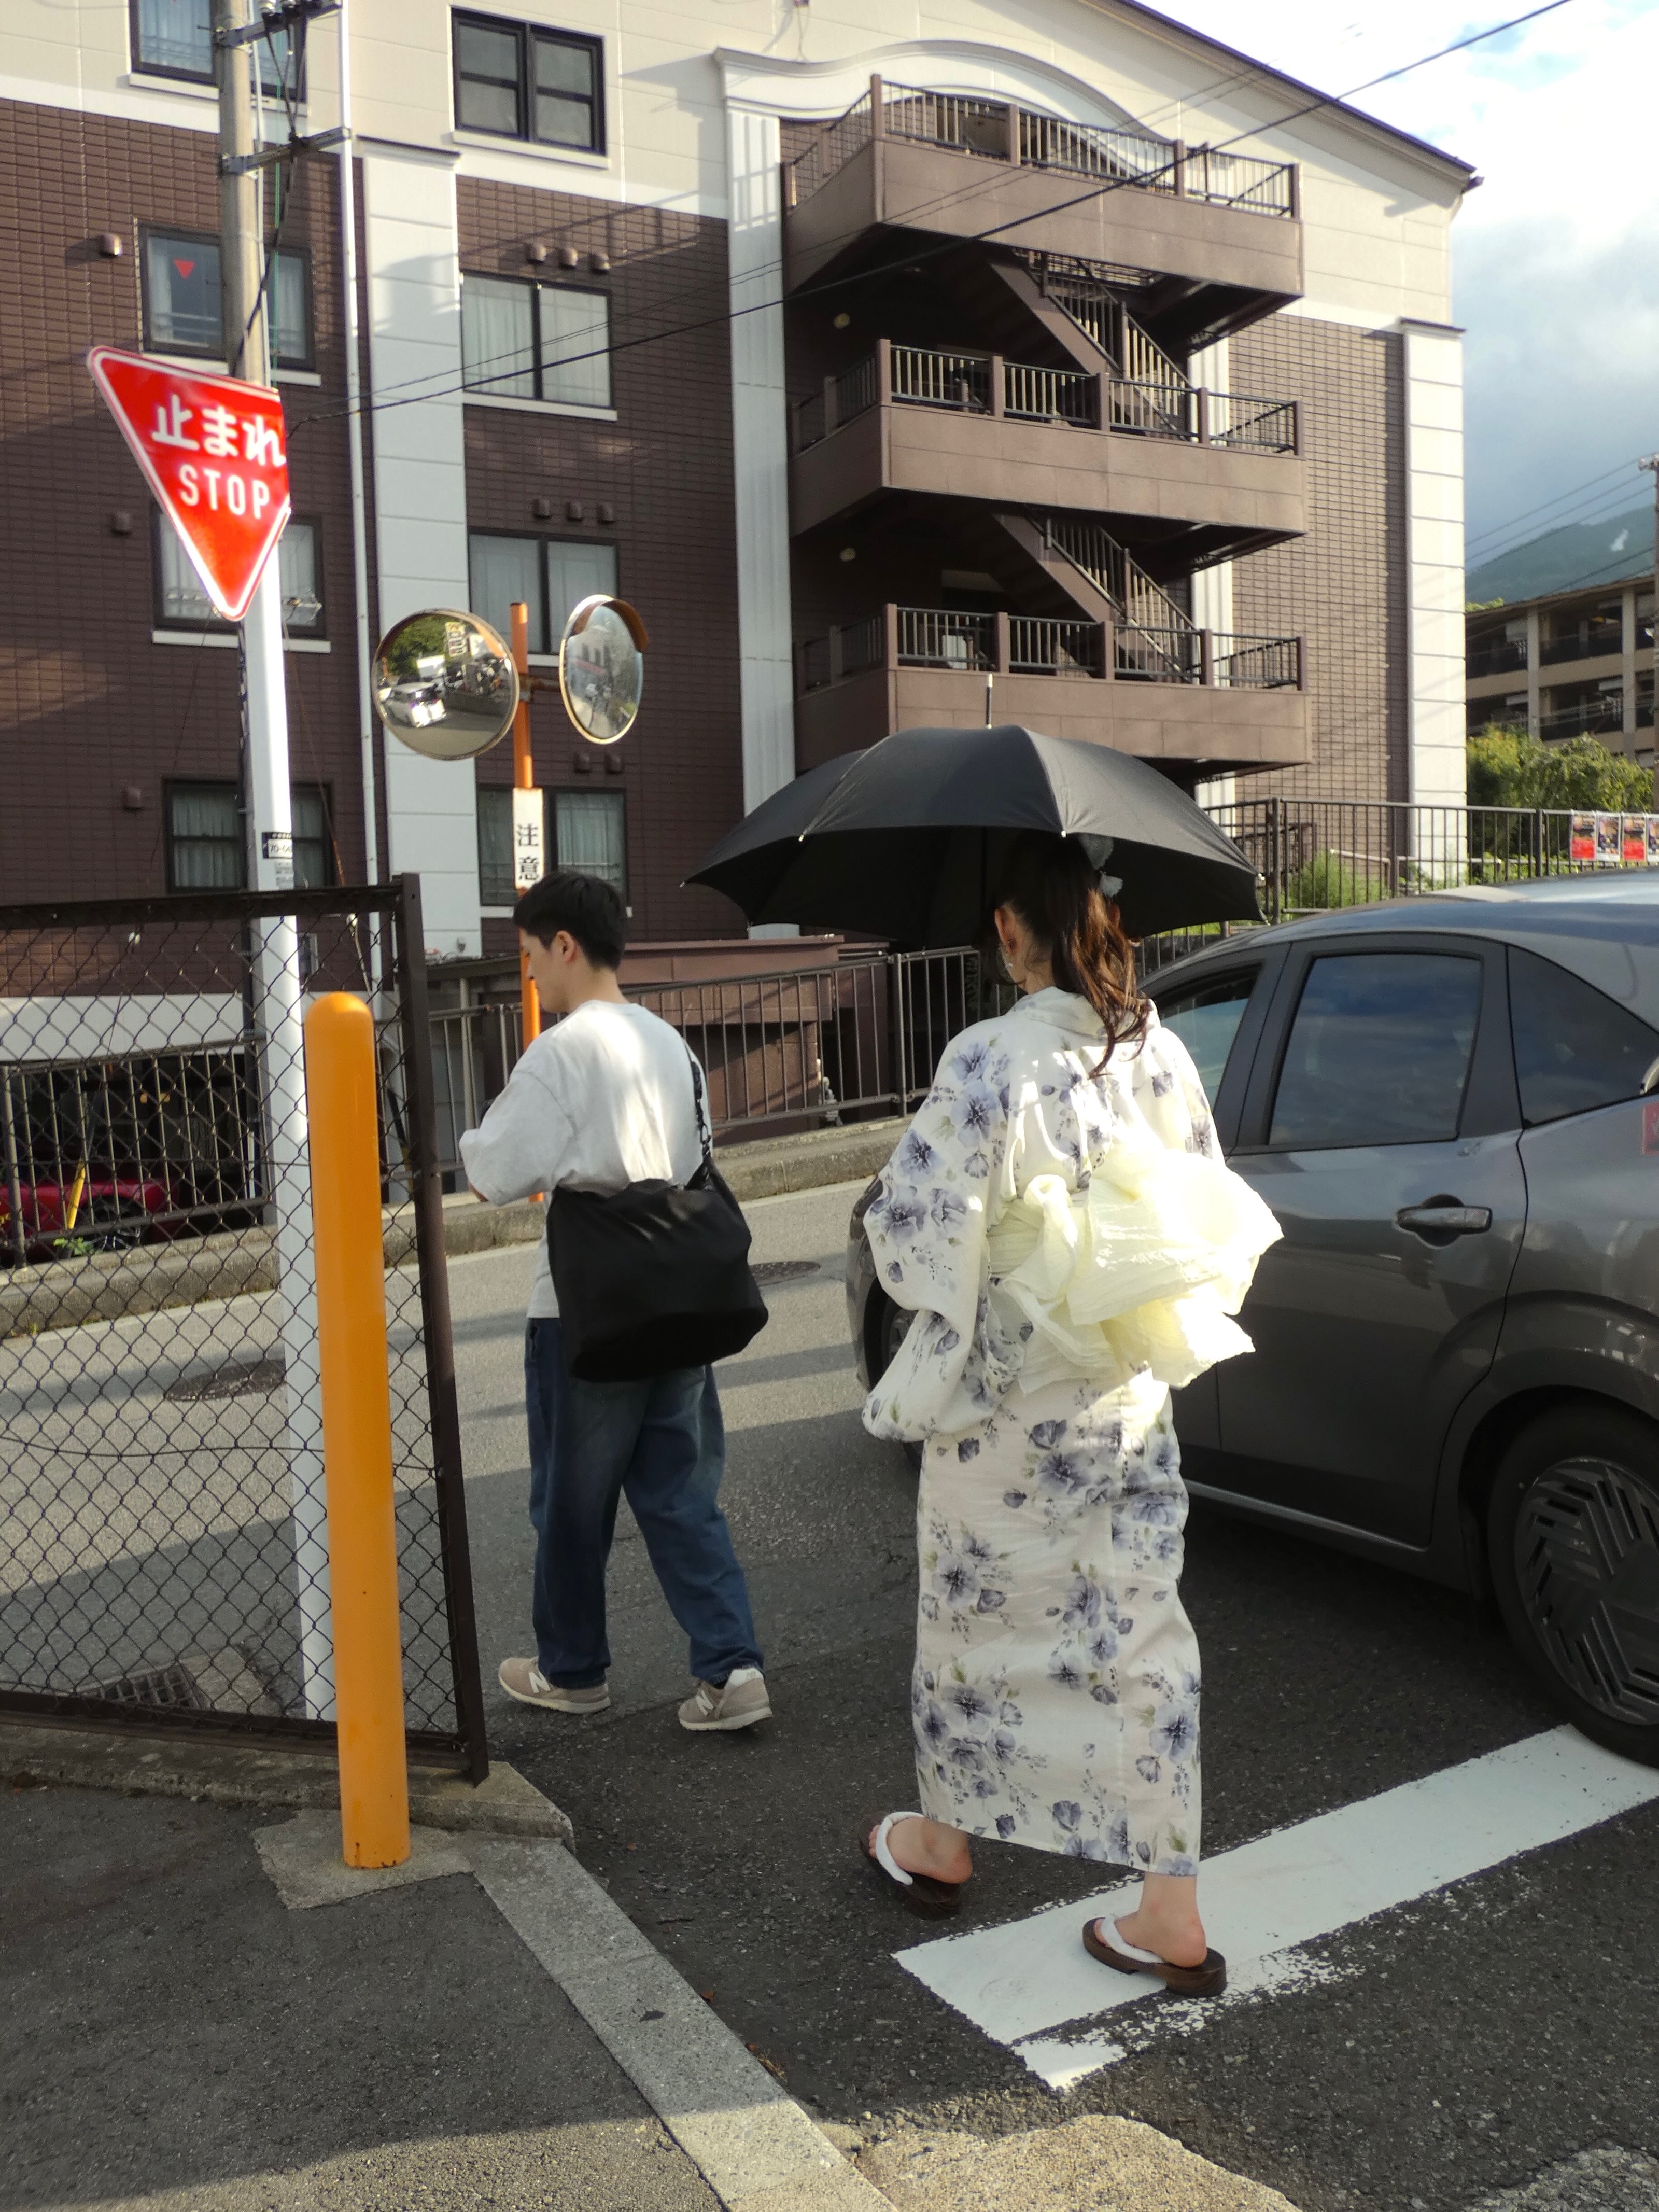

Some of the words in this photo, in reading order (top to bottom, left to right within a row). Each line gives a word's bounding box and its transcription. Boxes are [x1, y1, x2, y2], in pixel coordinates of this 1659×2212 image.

[151, 393, 287, 467] 止まれ
[179, 464, 269, 519] STOP
[517, 822, 539, 881] 注意
